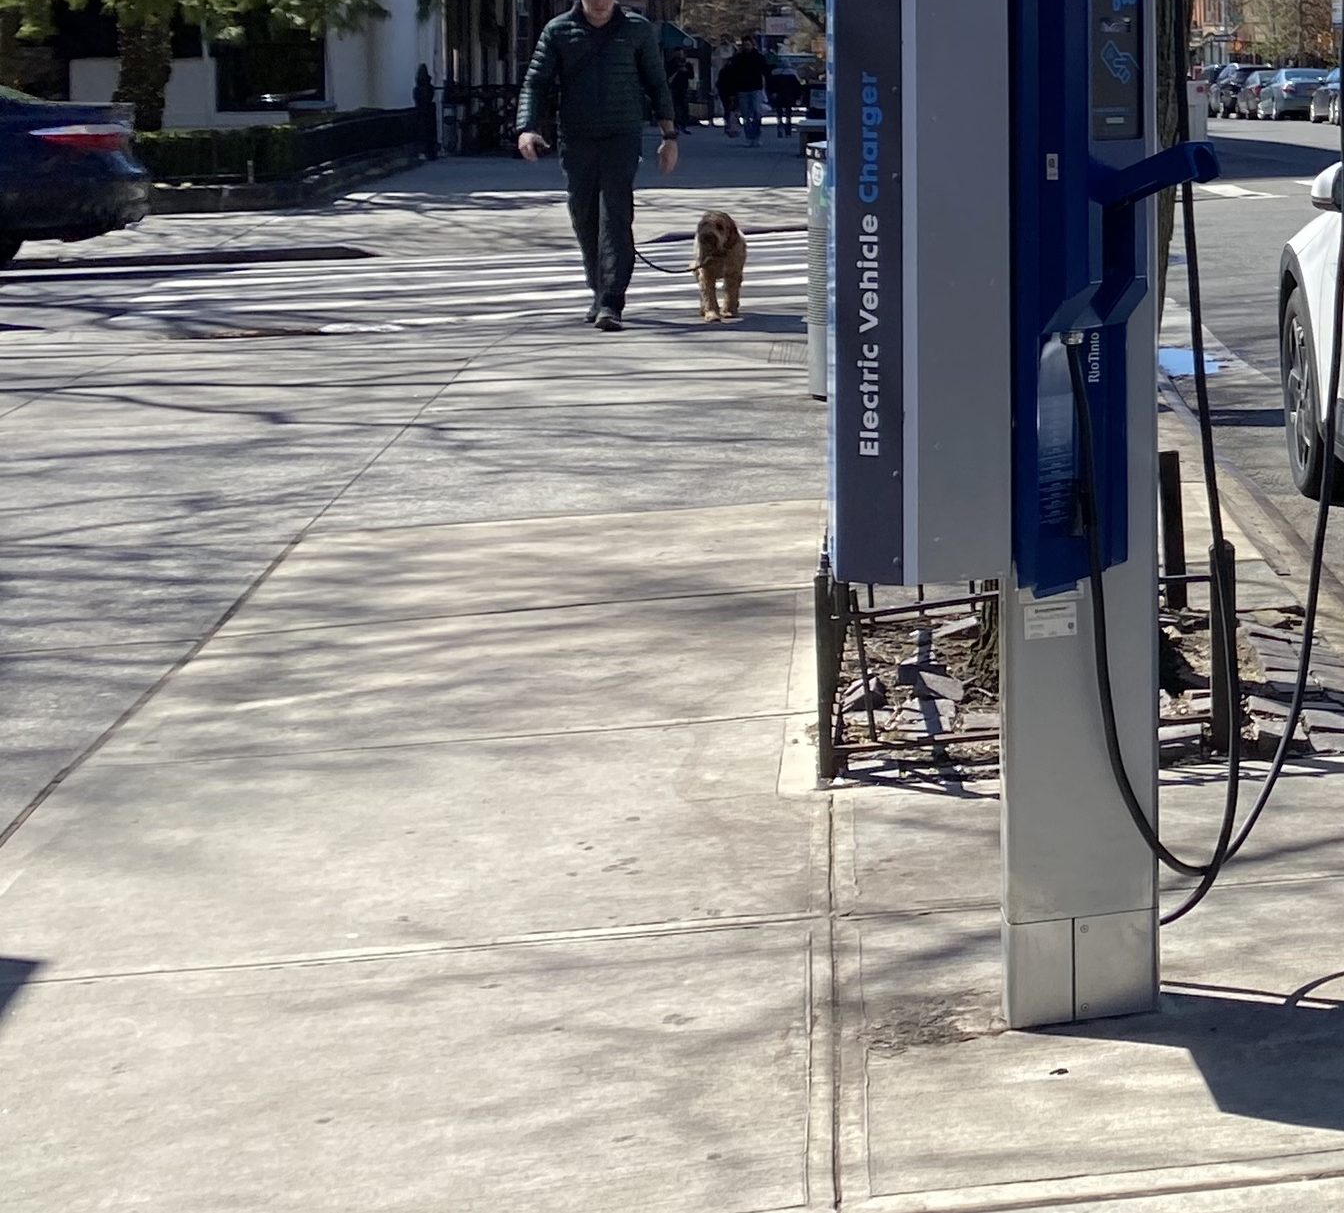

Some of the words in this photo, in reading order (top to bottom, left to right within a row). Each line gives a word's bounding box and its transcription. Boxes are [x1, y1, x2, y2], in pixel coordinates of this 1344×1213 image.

[858, 71, 883, 204] Charger
[858, 213, 880, 333] Vehicle
[858, 344, 880, 457] Electric
